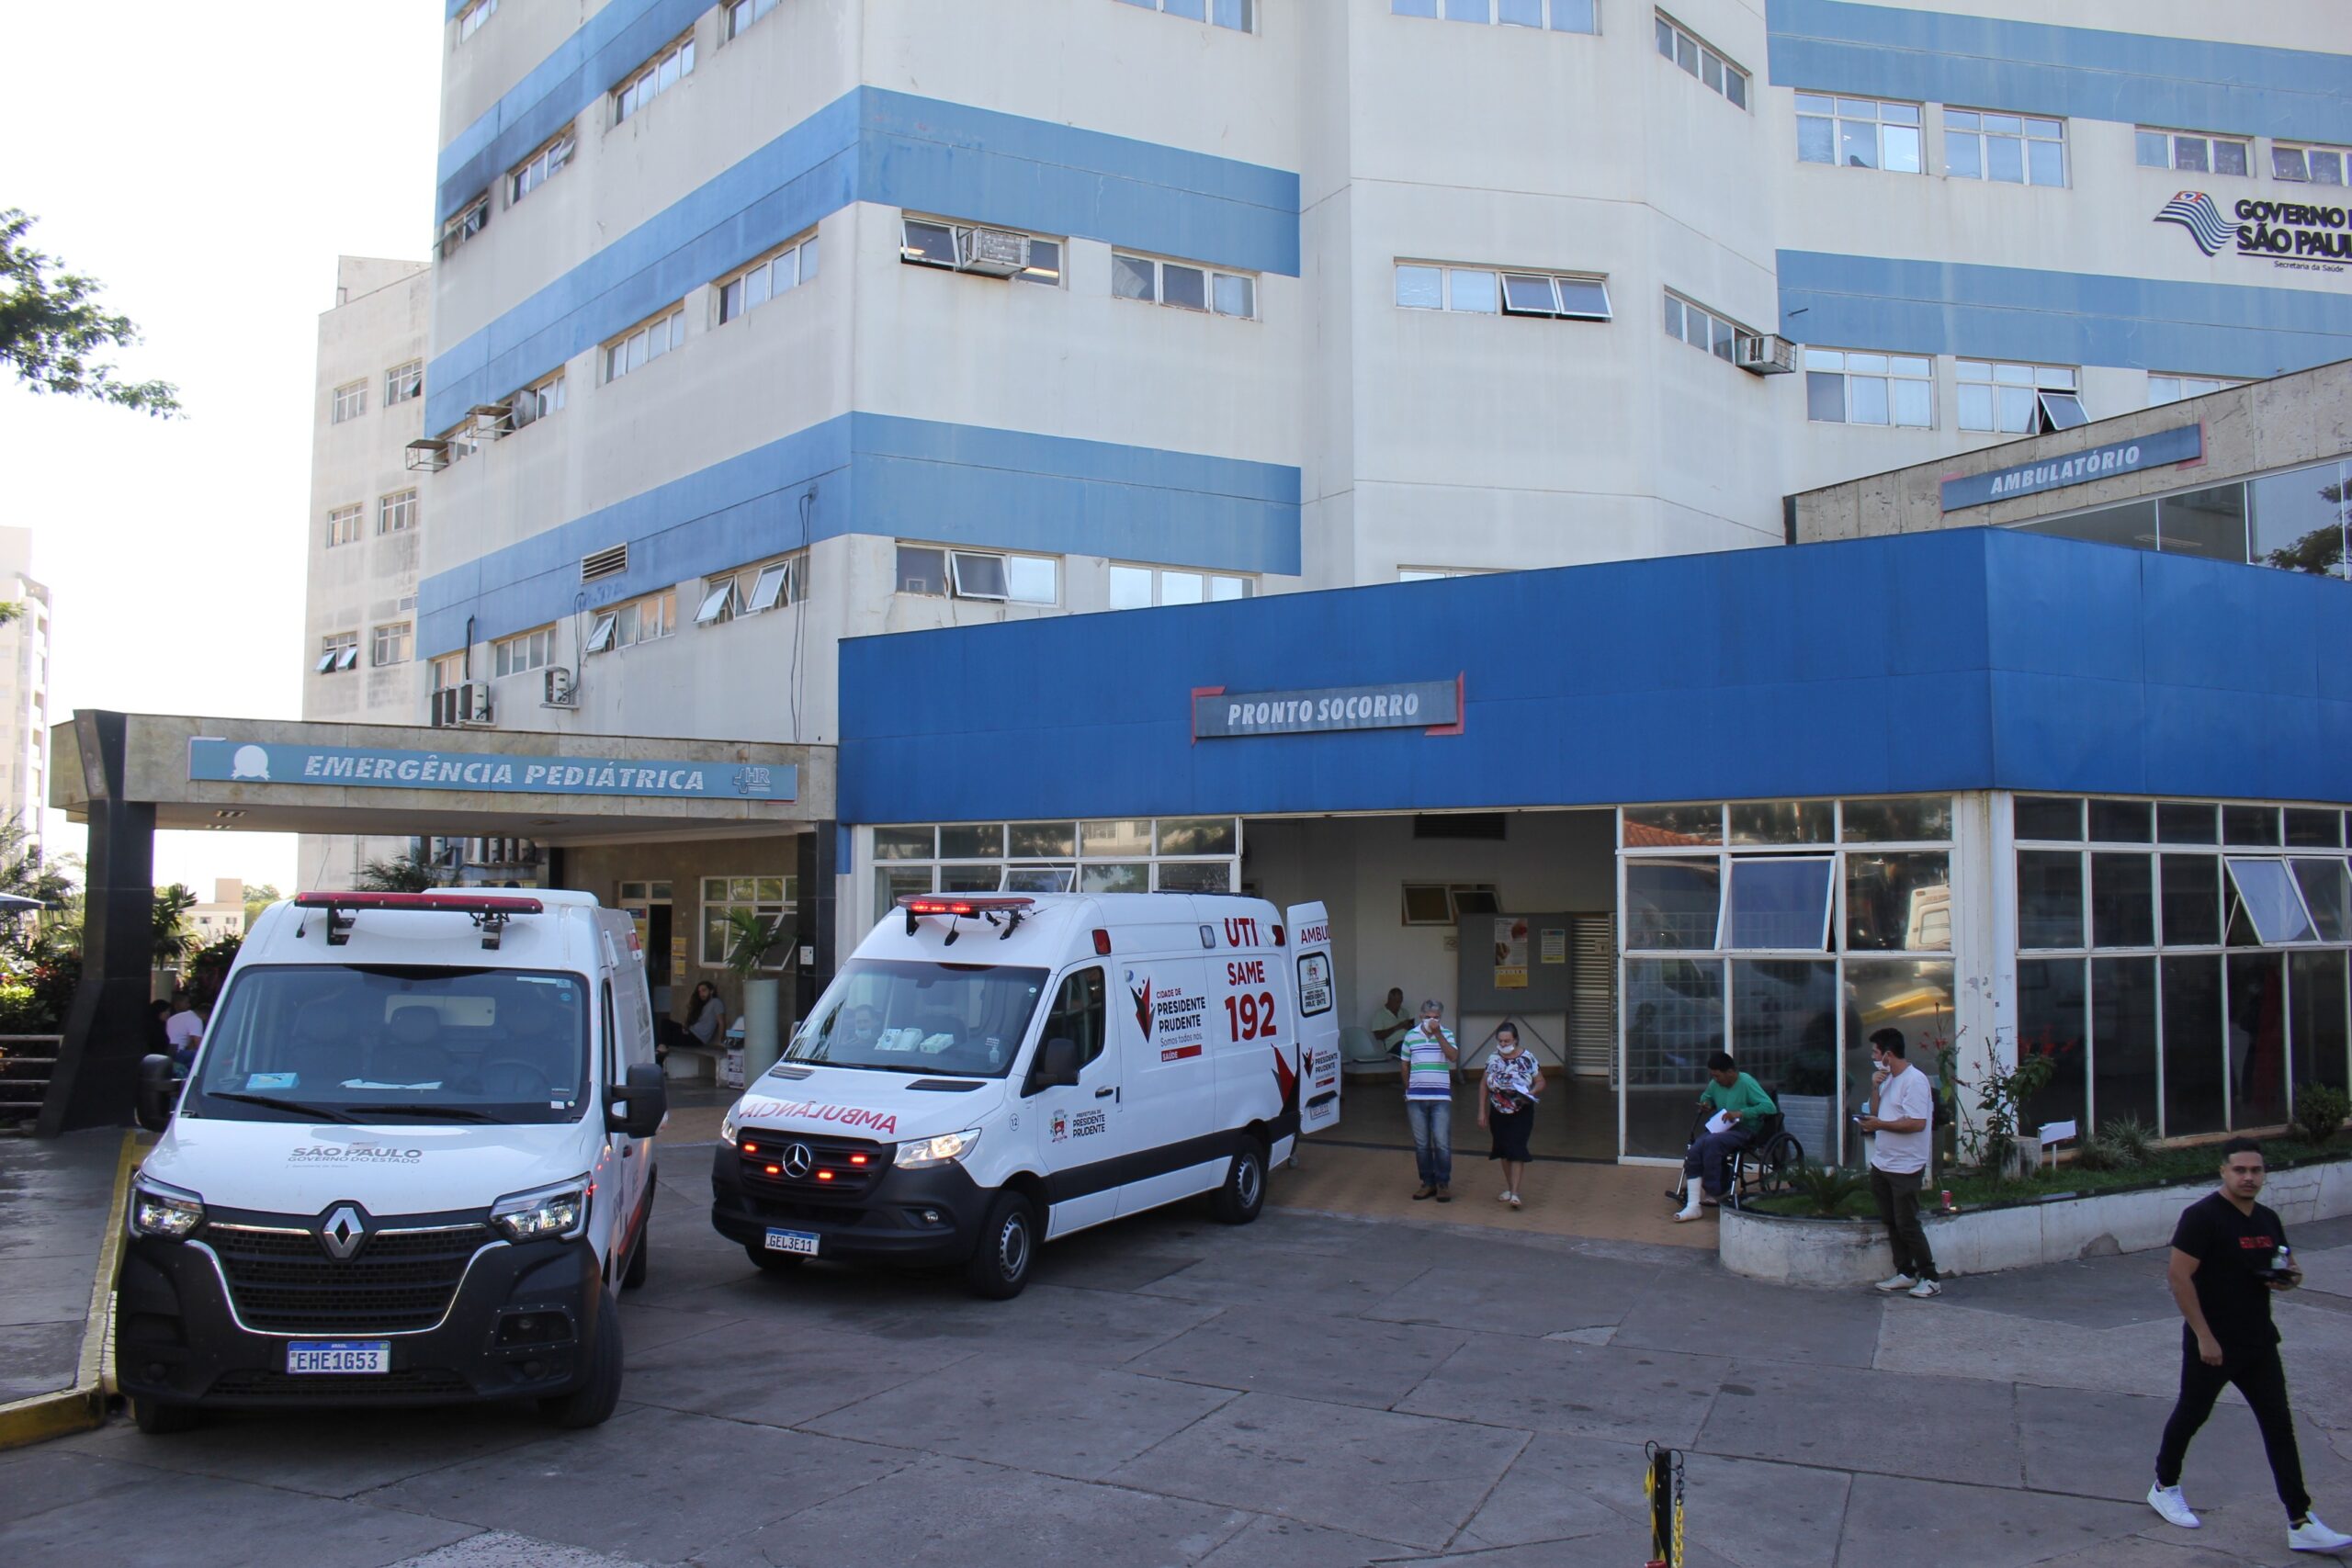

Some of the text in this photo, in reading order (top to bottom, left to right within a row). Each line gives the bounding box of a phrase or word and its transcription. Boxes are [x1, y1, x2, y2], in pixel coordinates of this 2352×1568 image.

[2234, 199, 2346, 229] GOVERNO
[2236, 222, 2292, 254] SÃO
[2274, 261, 2309, 270] Secretaria
[1990, 446, 2140, 494] AMBULATÓRIO
[1227, 693, 1419, 726] PRONTO SOCORRO
[304, 755, 704, 791] EMERGÊNCIA PEDIÁTRICA
[745, 767, 770, 784] HR
[1224, 918, 1259, 947] UTI
[1227, 961, 1265, 986] SAME
[1157, 987, 1182, 998] CIDADE DE
[1158, 997, 1205, 1016] PRESIDENTE
[1159, 1014, 1202, 1033] PRUDENTE
[1225, 991, 1277, 1043] 192
[1160, 1037, 1178, 1047] Somos
[1179, 1033, 1193, 1043] todos
[1011, 1118, 1018, 1126] 12
[1073, 1114, 1105, 1127] PRESIDENTE
[1073, 1123, 1105, 1138] PRUDENTE
[291, 1145, 423, 1158] SÃO PAULO
[770, 1235, 812, 1252] GEL3E11
[297, 1352, 379, 1371] EHE1G53
